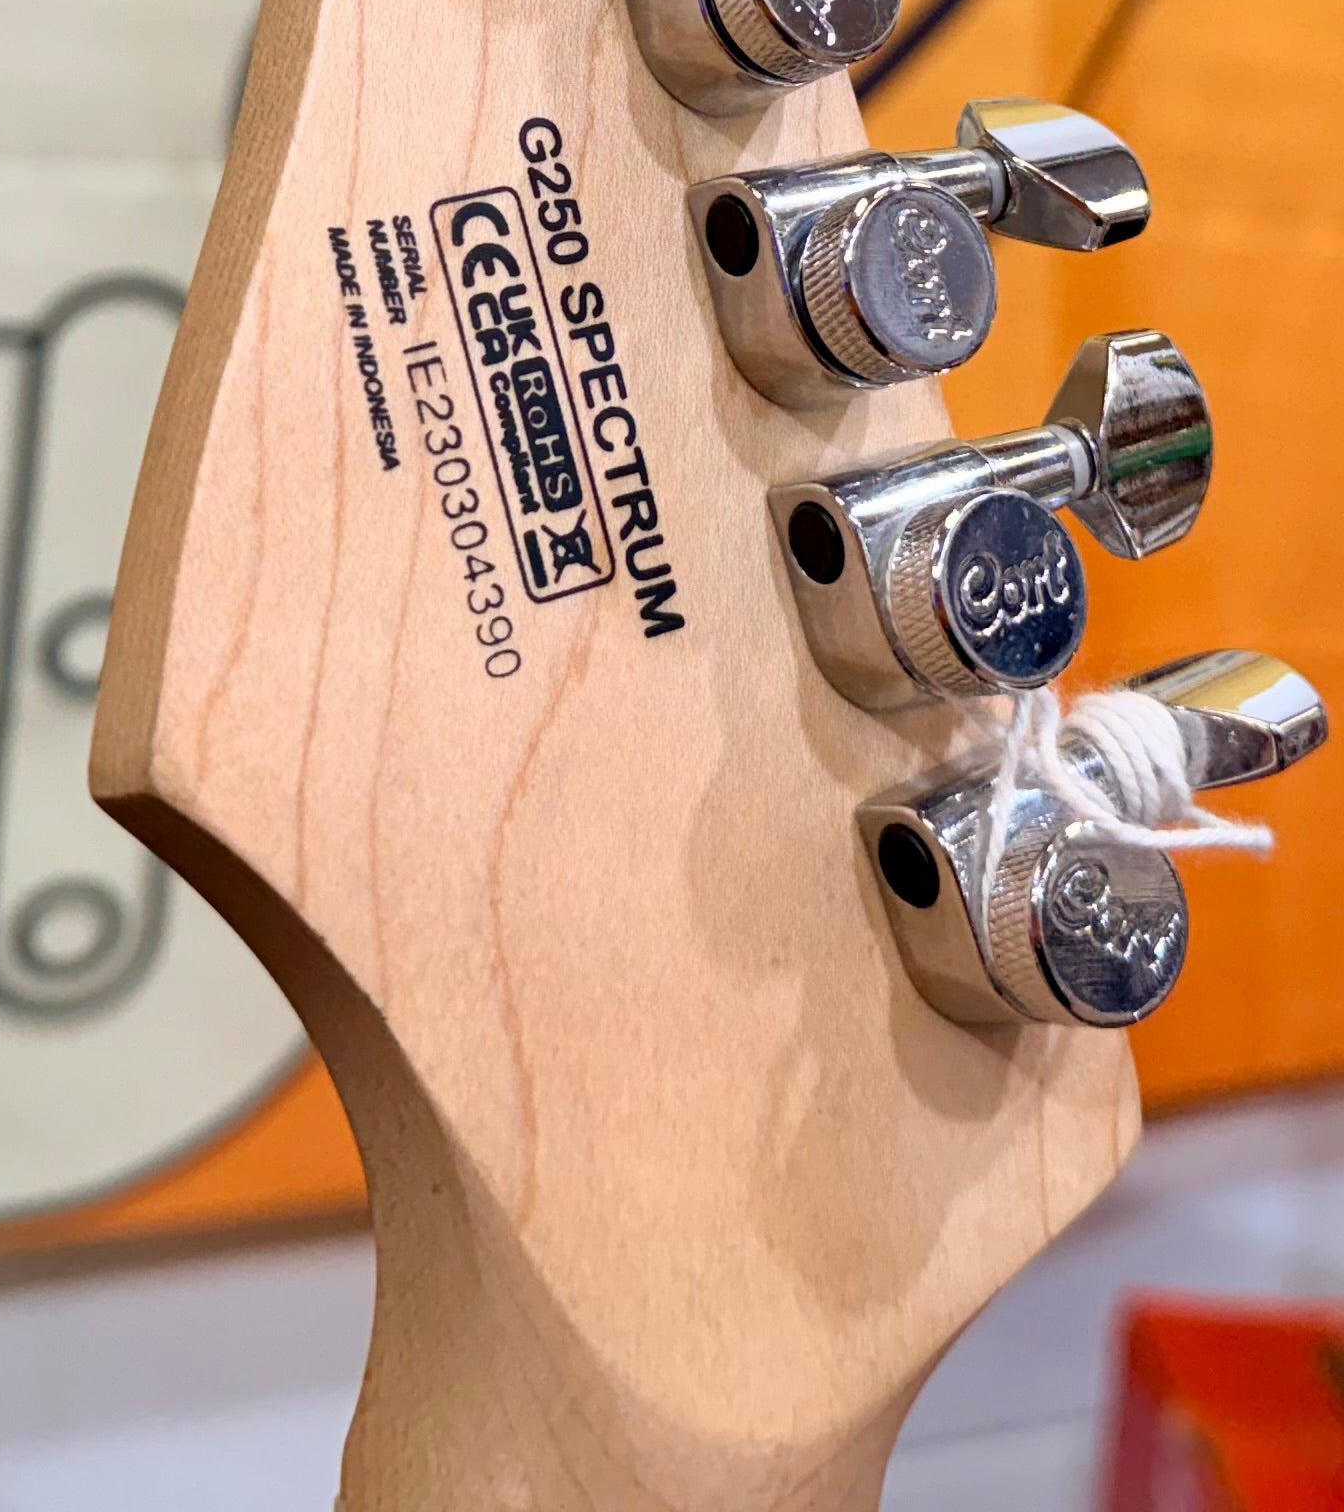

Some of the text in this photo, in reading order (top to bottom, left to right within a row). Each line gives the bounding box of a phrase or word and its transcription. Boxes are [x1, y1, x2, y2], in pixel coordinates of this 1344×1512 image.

[366, 218, 408, 326] NUMBER
[392, 214, 427, 300] SERIAL
[327, 226, 400, 472] MADE IN INDONESIA
[467, 291, 509, 366] CA
[498, 283, 542, 357] UK
[518, 116, 686, 639] G250 SPECTRUM
[516, 368, 574, 502] RoHS
[402, 340, 522, 679] IE230304390
[959, 533, 1072, 638] Cort
